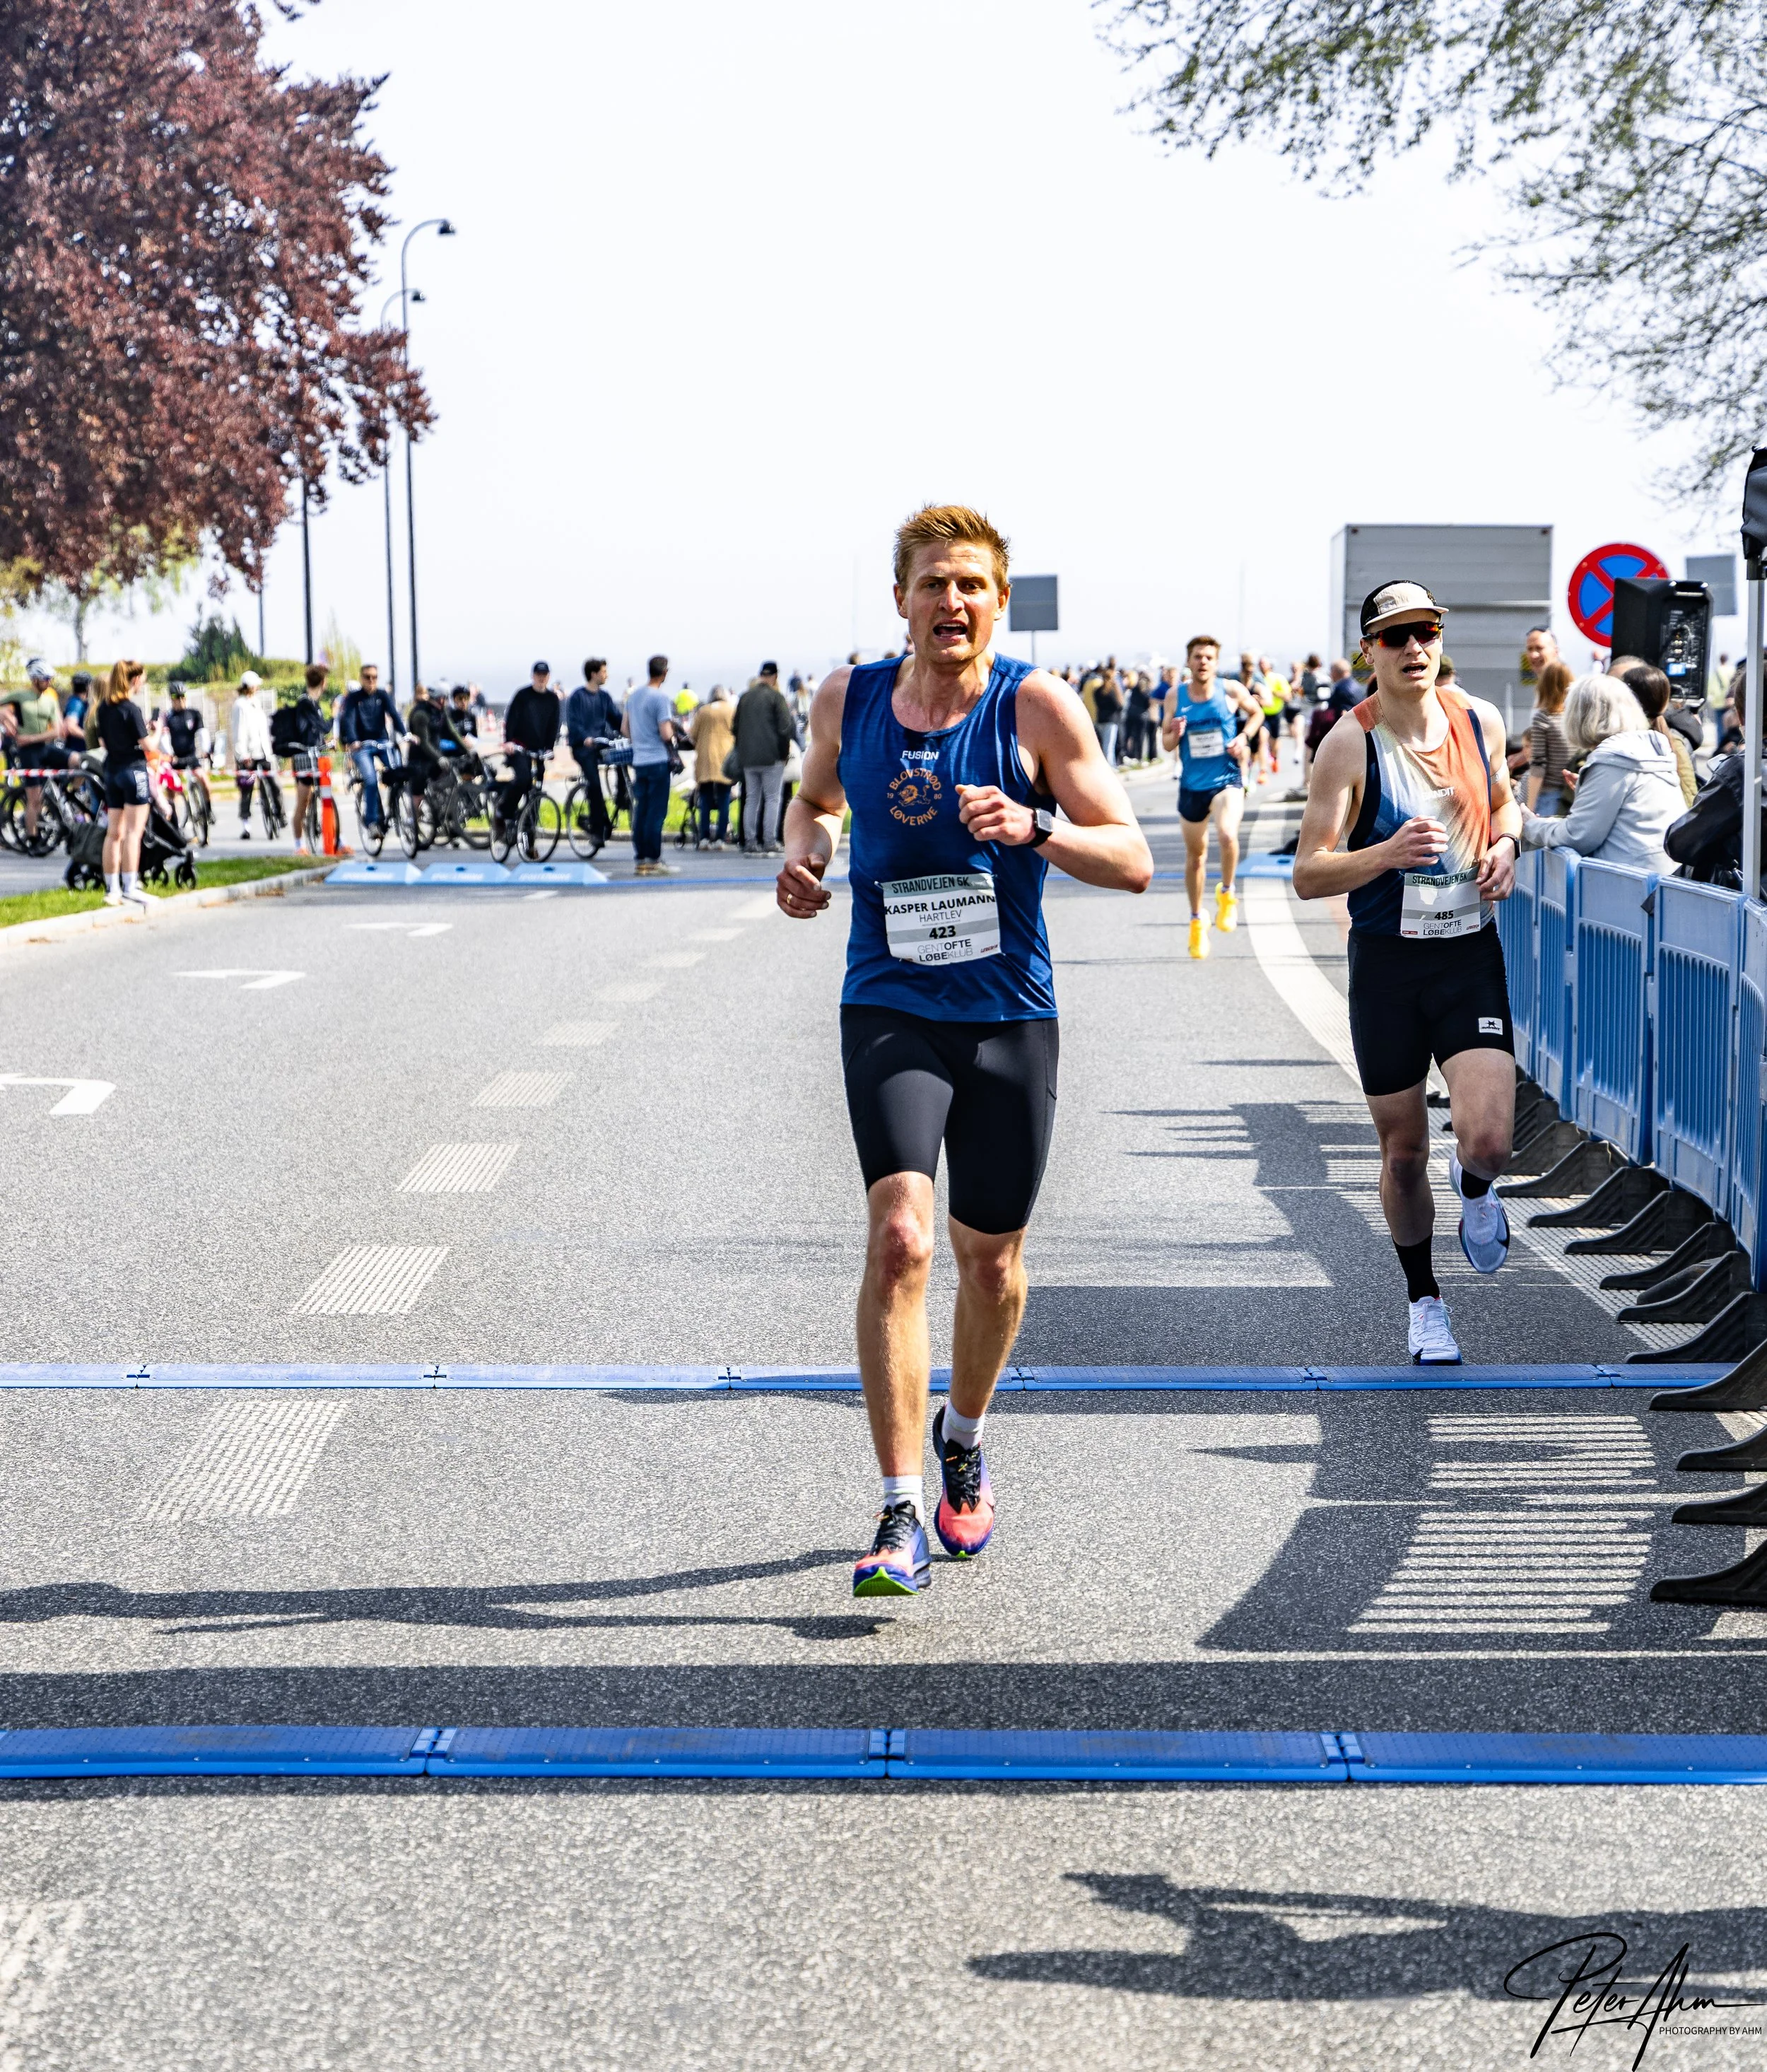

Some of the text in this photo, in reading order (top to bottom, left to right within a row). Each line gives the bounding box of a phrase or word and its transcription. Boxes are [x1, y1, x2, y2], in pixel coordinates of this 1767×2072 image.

[902, 750, 939, 760] FUSION
[889, 805, 939, 826] LØVERNE
[891, 877, 956, 894] STRANDVEJEN
[1413, 872, 1468, 886] STRANDVEJEN 5K
[884, 895, 996, 915] KASPER LAUMANN
[919, 909, 962, 923] HARTLEV
[1434, 911, 1454, 920] 485
[1423, 920, 1462, 930] GENTOFTE
[1423, 926, 1462, 936] LØBEKLUB
[929, 925, 956, 940] 423
[917, 939, 972, 954] GENTOFTE
[919, 947, 973, 962] LØBEKLUB
